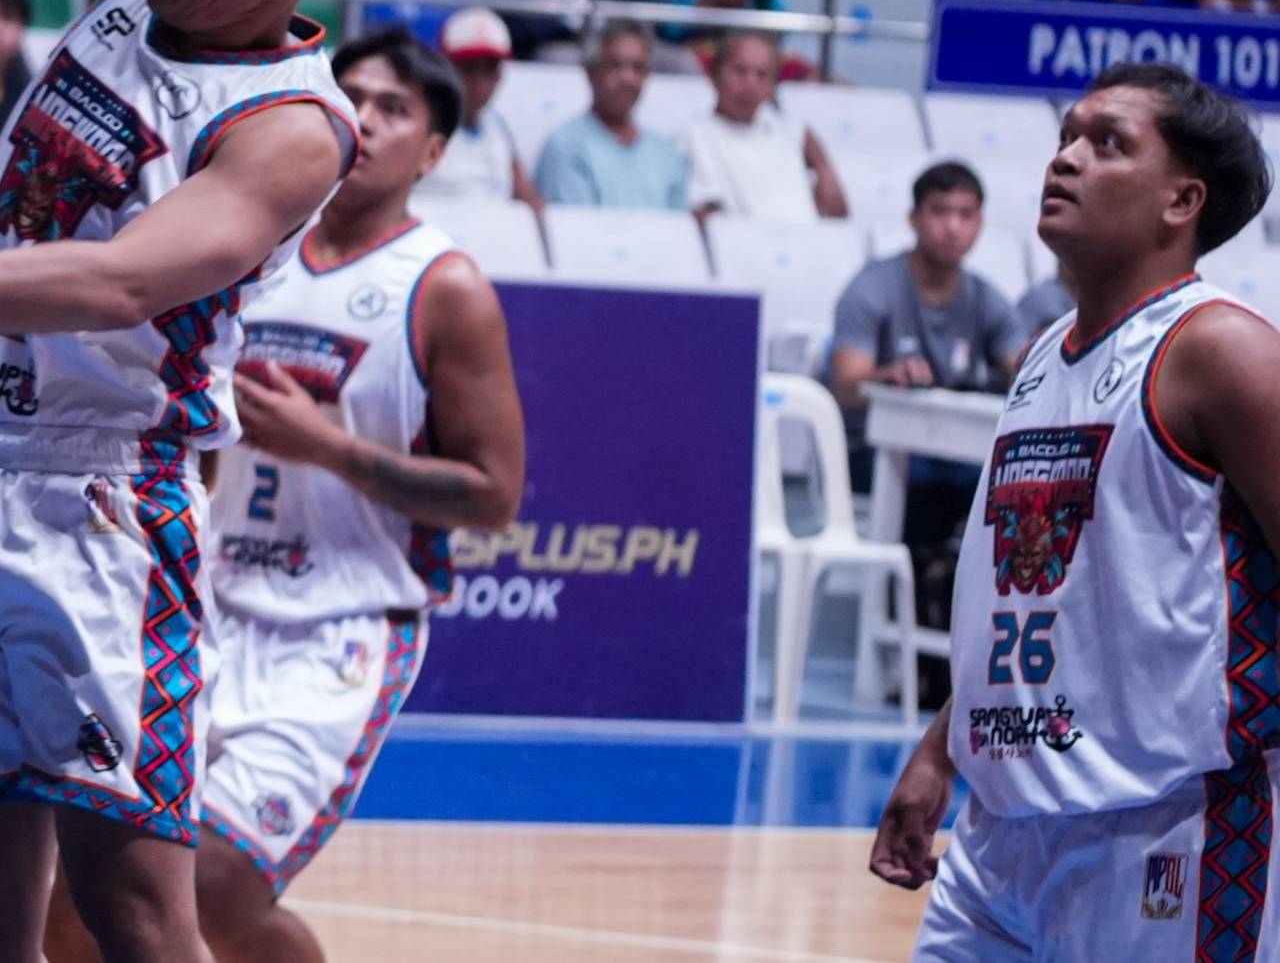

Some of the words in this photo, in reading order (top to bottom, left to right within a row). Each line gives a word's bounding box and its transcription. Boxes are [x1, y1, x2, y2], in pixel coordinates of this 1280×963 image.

[1027, 22, 1200, 78] PATRON
[1214, 35, 1280, 88] 101
[247, 464, 279, 523] 2
[987, 609, 1059, 686] 26
